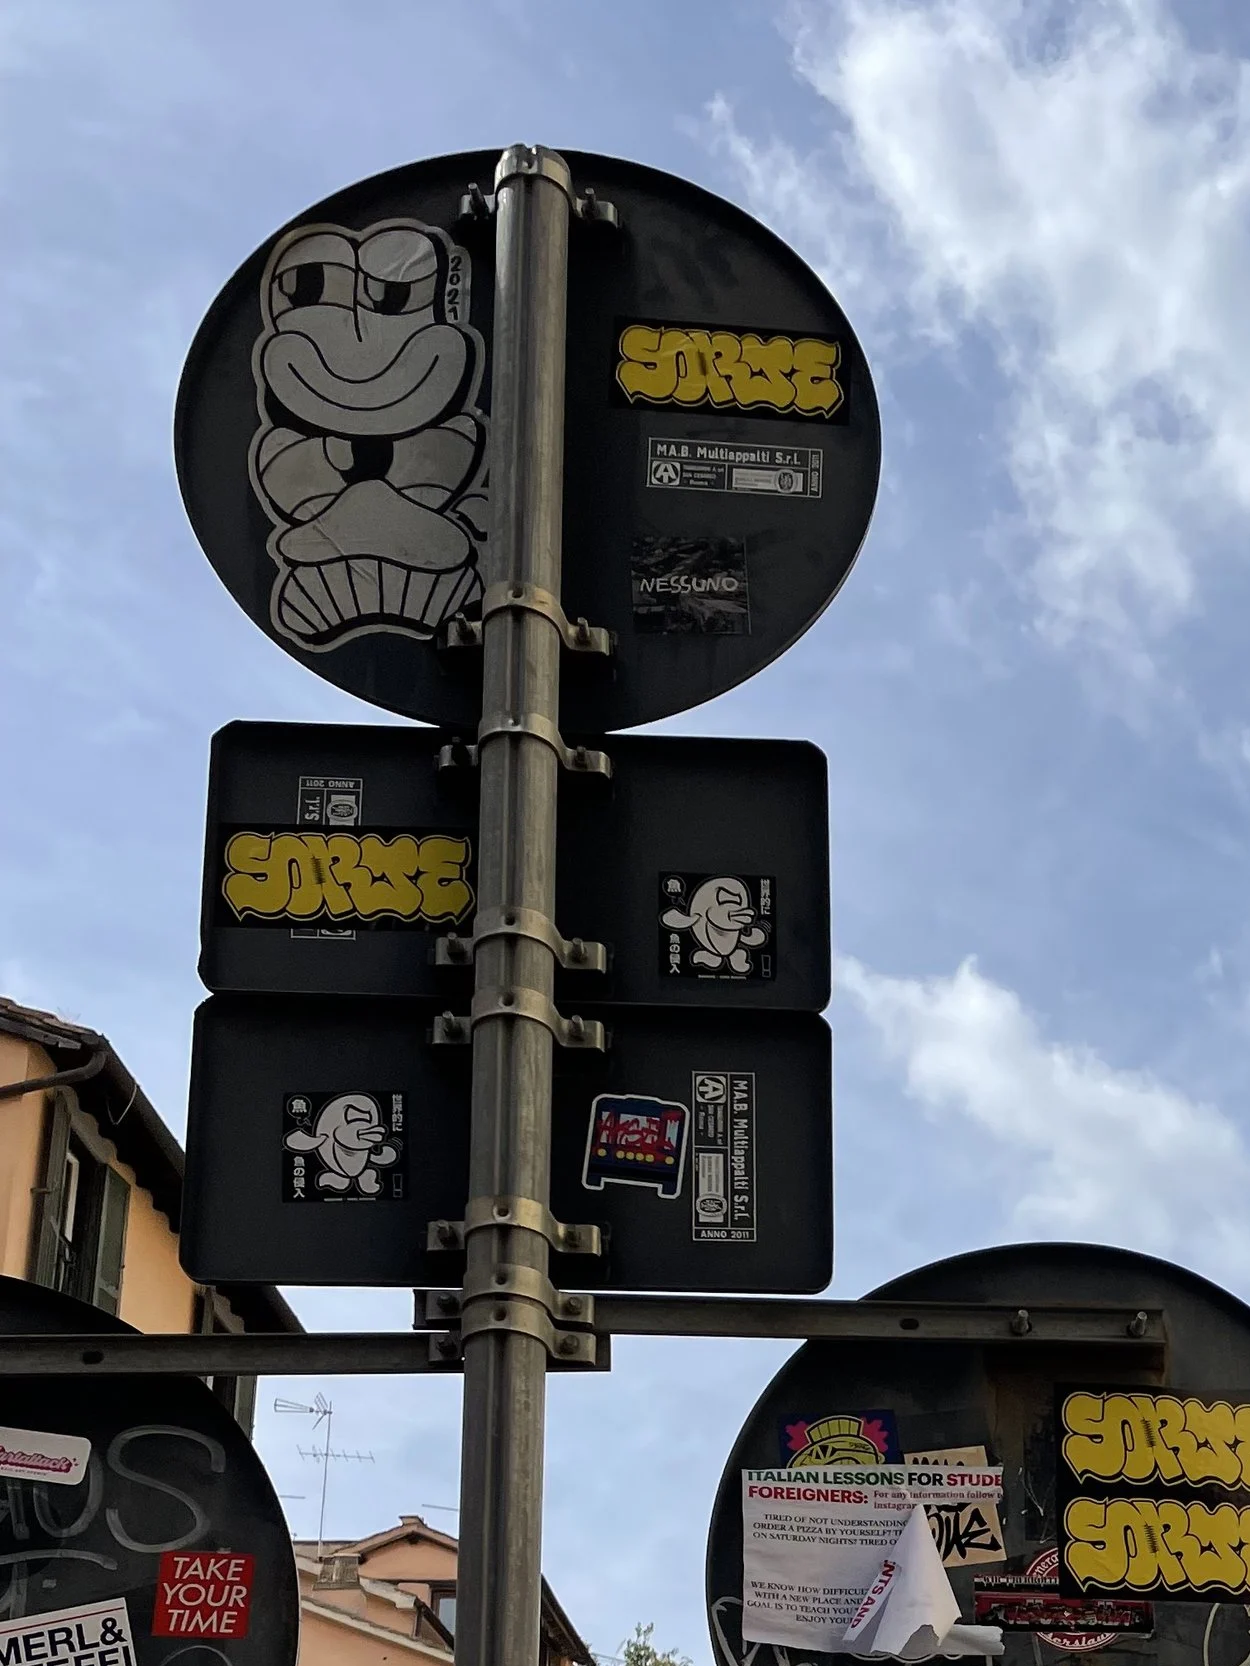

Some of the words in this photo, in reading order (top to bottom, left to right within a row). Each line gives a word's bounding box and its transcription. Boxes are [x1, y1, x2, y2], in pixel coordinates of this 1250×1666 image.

[640, 575, 738, 594] NESSUNO
[731, 1118, 750, 1190] Multiappalti
[700, 1230, 727, 1239] ANNO
[731, 1230, 749, 1239] 2011
[748, 1471, 820, 1484] ITALIAN
[823, 1472, 905, 1486] LESSONS
[907, 1472, 944, 1486] FOR
[748, 1485, 869, 1504] FOREIGNERS:
[891, 1491, 907, 1501] any
[764, 1513, 793, 1522] TIRED
[794, 1515, 807, 1523] OF
[810, 1517, 828, 1525] NOT
[753, 1522, 787, 1531] ORDER
[788, 1524, 795, 1532] A
[797, 1525, 823, 1534] PIZZA
[825, 1527, 838, 1535] BY
[769, 1533, 818, 1543] SATURDAY
[859, 1538, 888, 1546] TIRED
[173, 1557, 245, 1581] TAKE
[751, 1581, 767, 1589] WE
[767, 1583, 795, 1591] KNOW
[162, 1583, 248, 1607] YOUR
[754, 1591, 779, 1599] WITH
[789, 1594, 811, 1602] NEW
[812, 1596, 841, 1604] PLACE
[747, 1600, 772, 1608] GOAL
[785, 1603, 797, 1612] TO
[799, 1605, 830, 1614] TEACH
[167, 1609, 238, 1634] TIME
[796, 1615, 827, 1623] ENJOY
